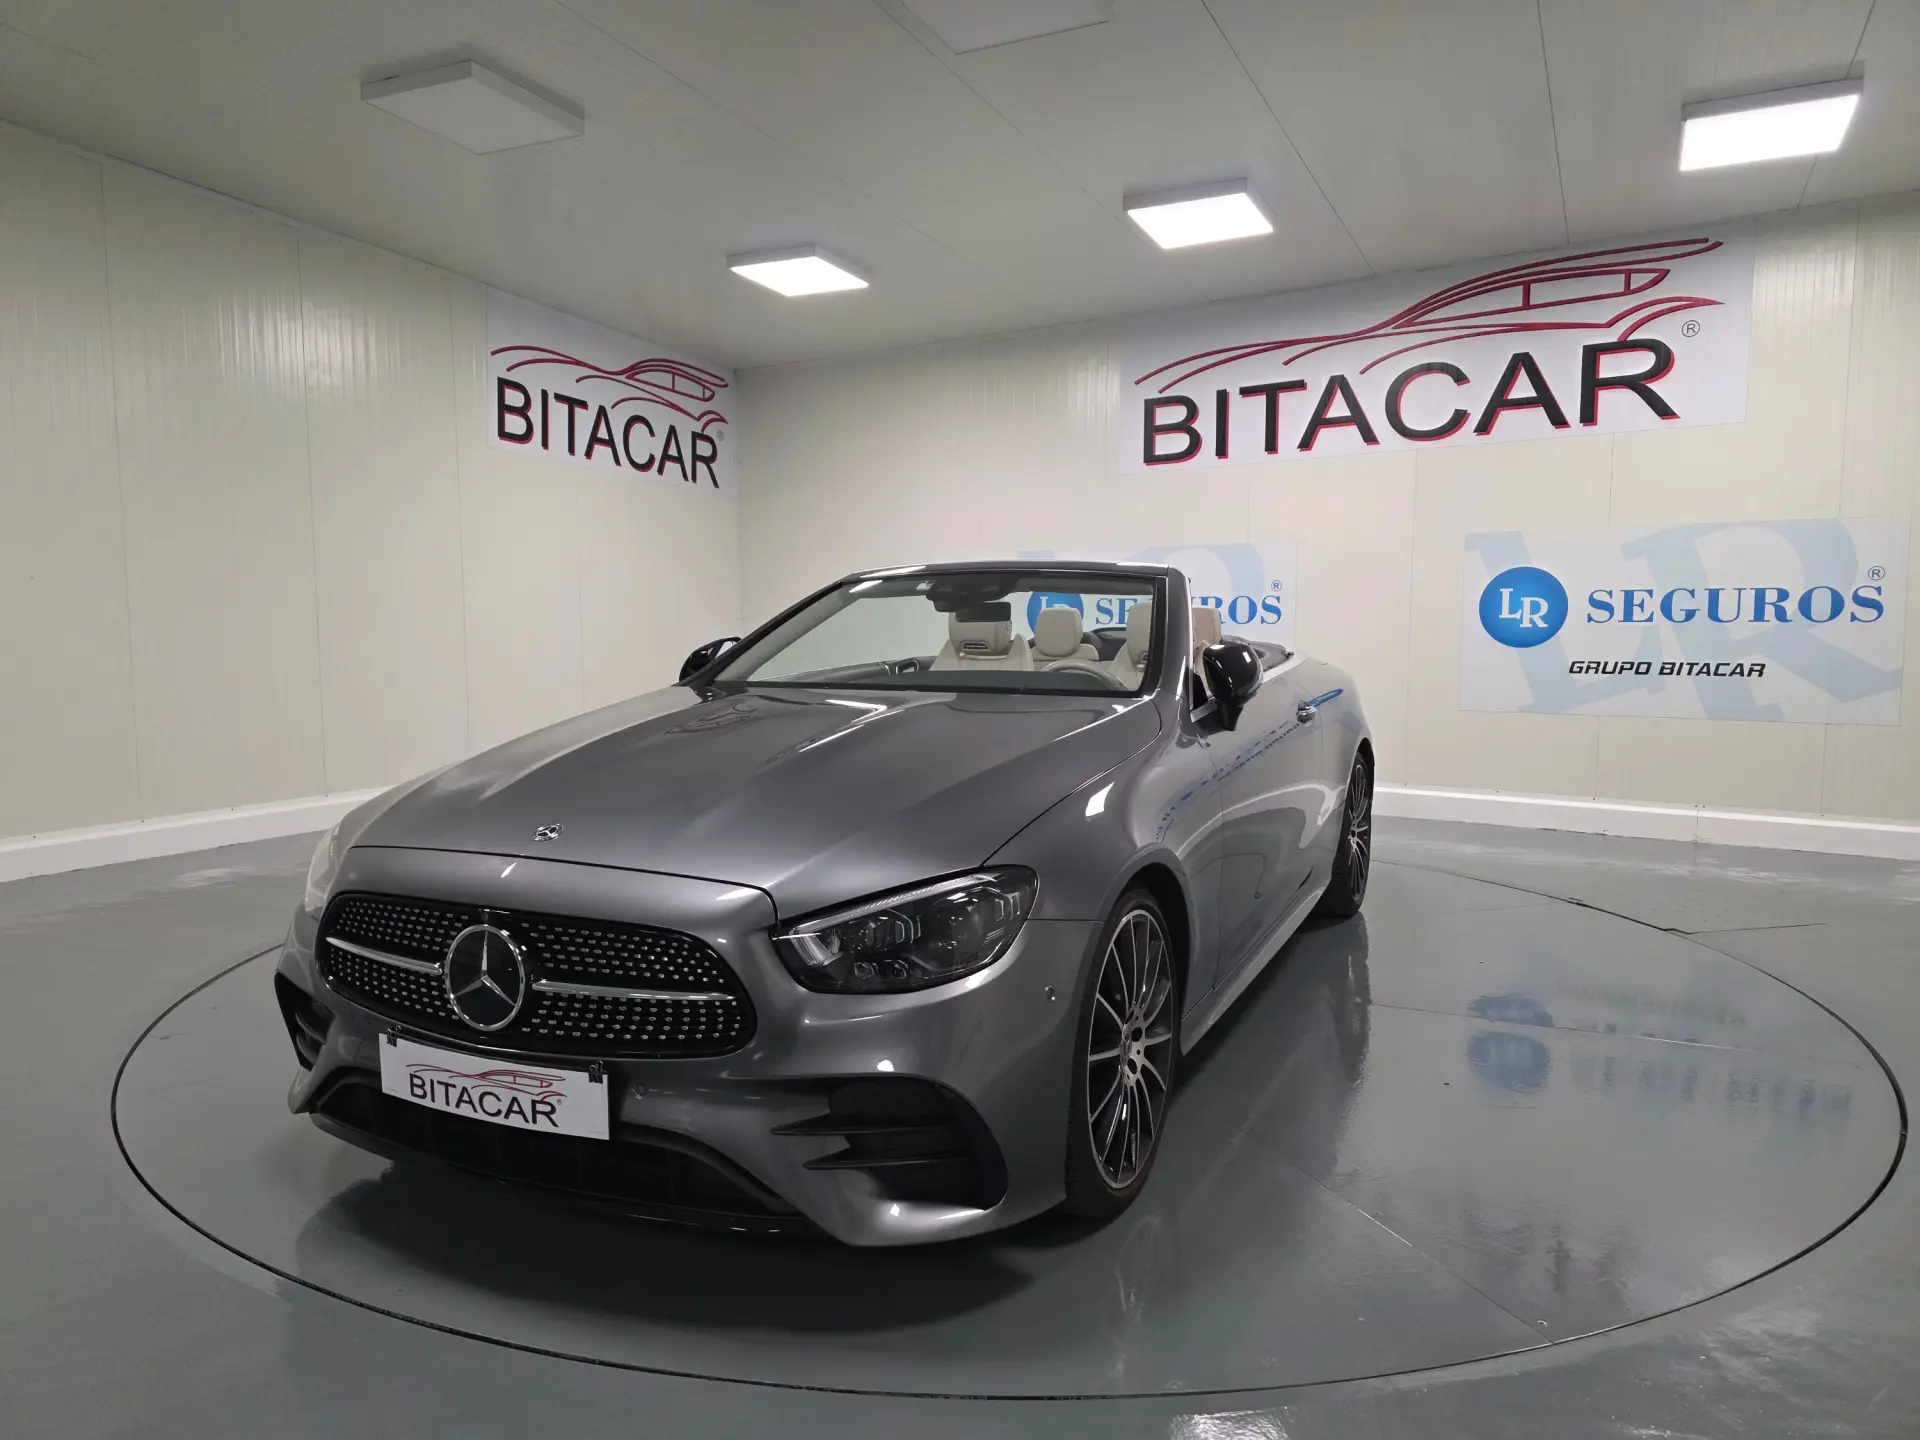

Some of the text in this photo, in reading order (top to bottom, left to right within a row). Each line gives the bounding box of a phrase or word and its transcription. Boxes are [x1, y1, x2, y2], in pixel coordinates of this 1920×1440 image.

[1142, 338, 1681, 466] BITACAR
[497, 376, 720, 489] BITACAR
[1498, 585, 1885, 628] LR SEGUROS
[1568, 660, 1766, 678] GRUPO BITACAR
[409, 1072, 559, 1128] BITACAR
